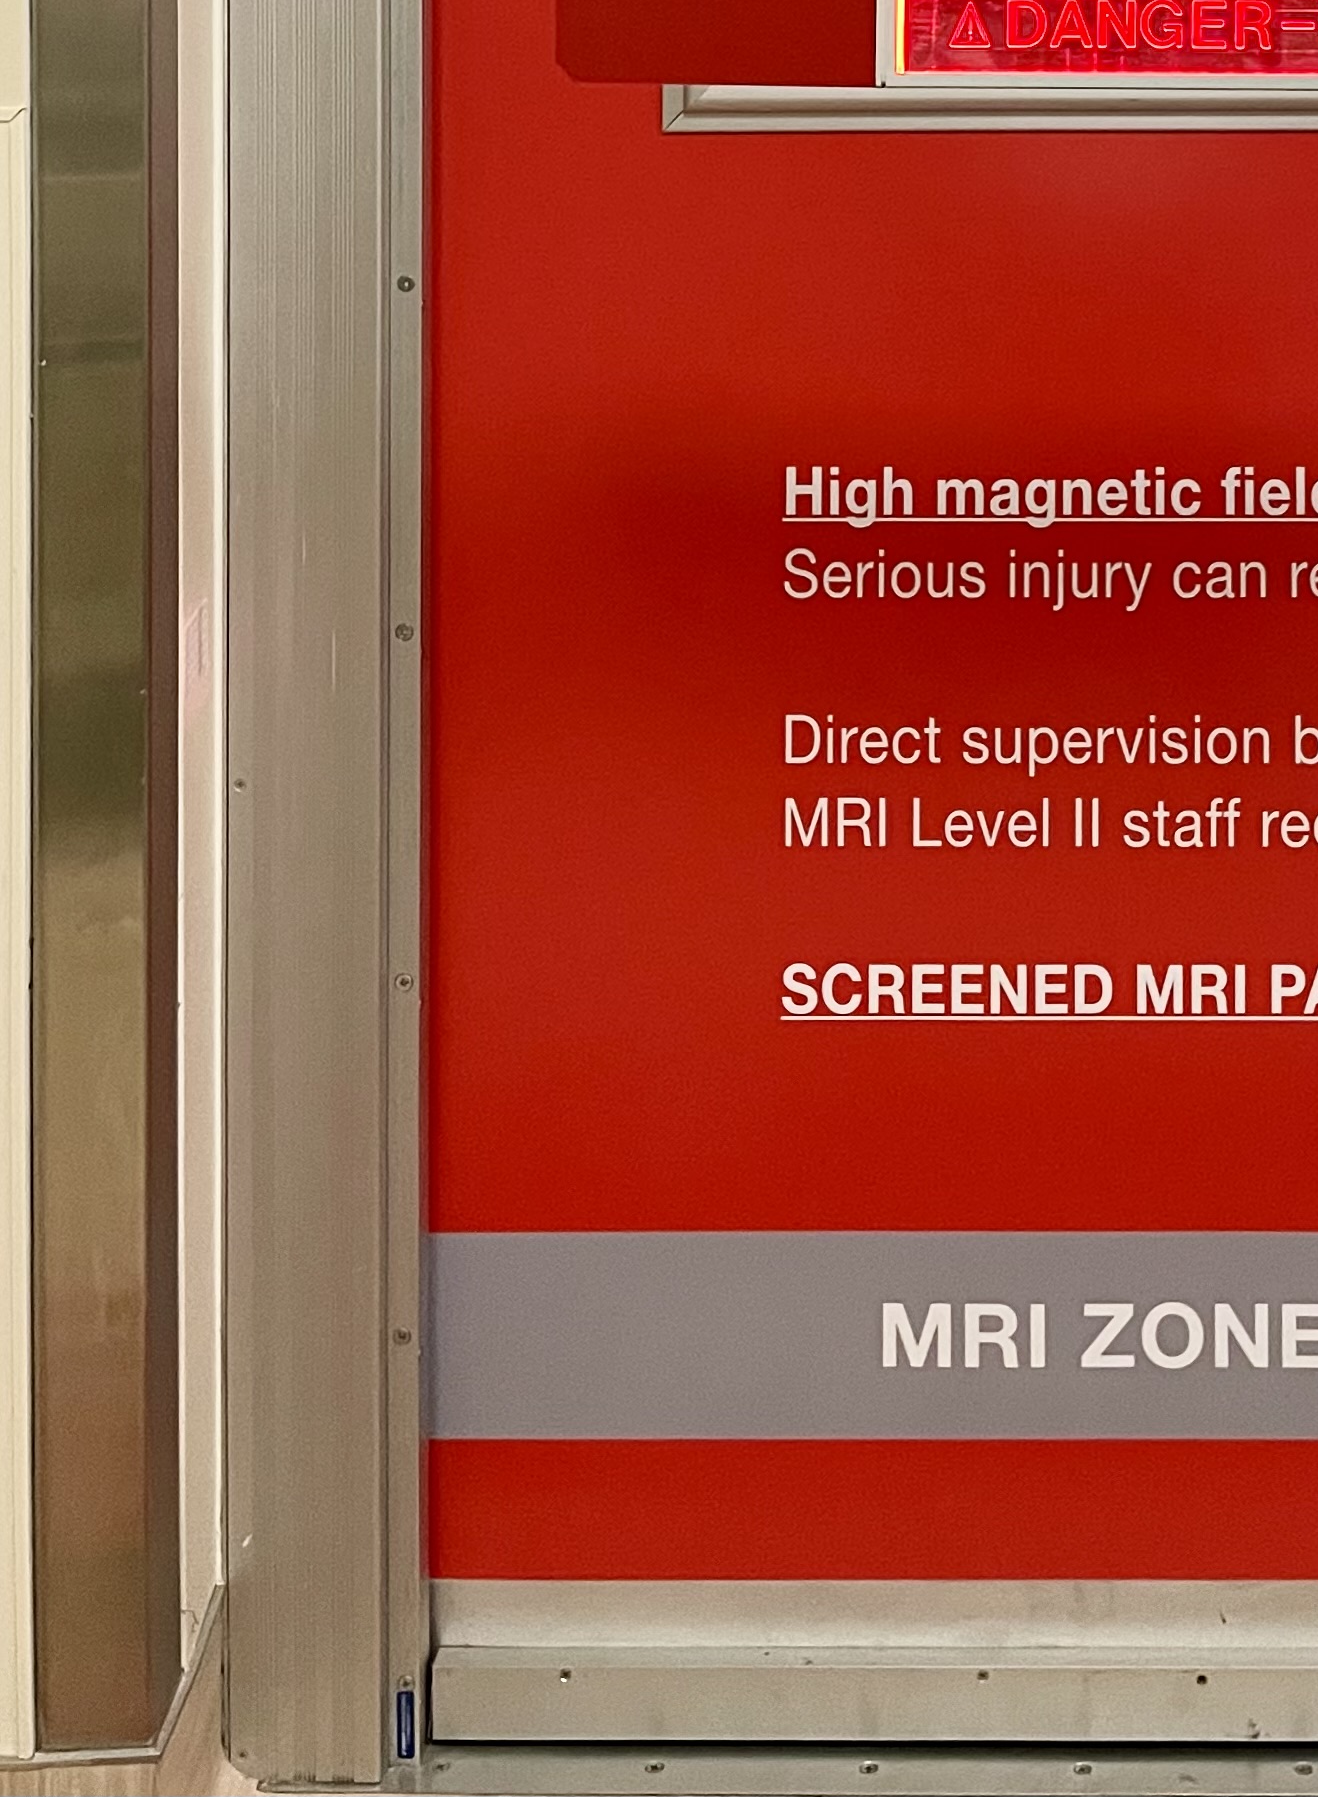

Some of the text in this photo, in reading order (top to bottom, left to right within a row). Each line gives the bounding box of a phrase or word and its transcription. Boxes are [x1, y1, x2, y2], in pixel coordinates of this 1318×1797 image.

[785, 466, 913, 528] High
[937, 466, 1201, 528] magnetic
[784, 548, 986, 599] Serious
[1009, 549, 1152, 612] injury
[1173, 561, 1267, 599] can
[785, 714, 941, 765] Direct
[962, 714, 1270, 778] supervision
[784, 797, 887, 847] MRI
[912, 797, 1049, 848] Level
[1075, 797, 1099, 848] II
[1123, 797, 1242, 848] staff
[781, 962, 1113, 1016] SCREENED
[1136, 963, 1246, 1015] MRI
[882, 1302, 1046, 1368] MRI
